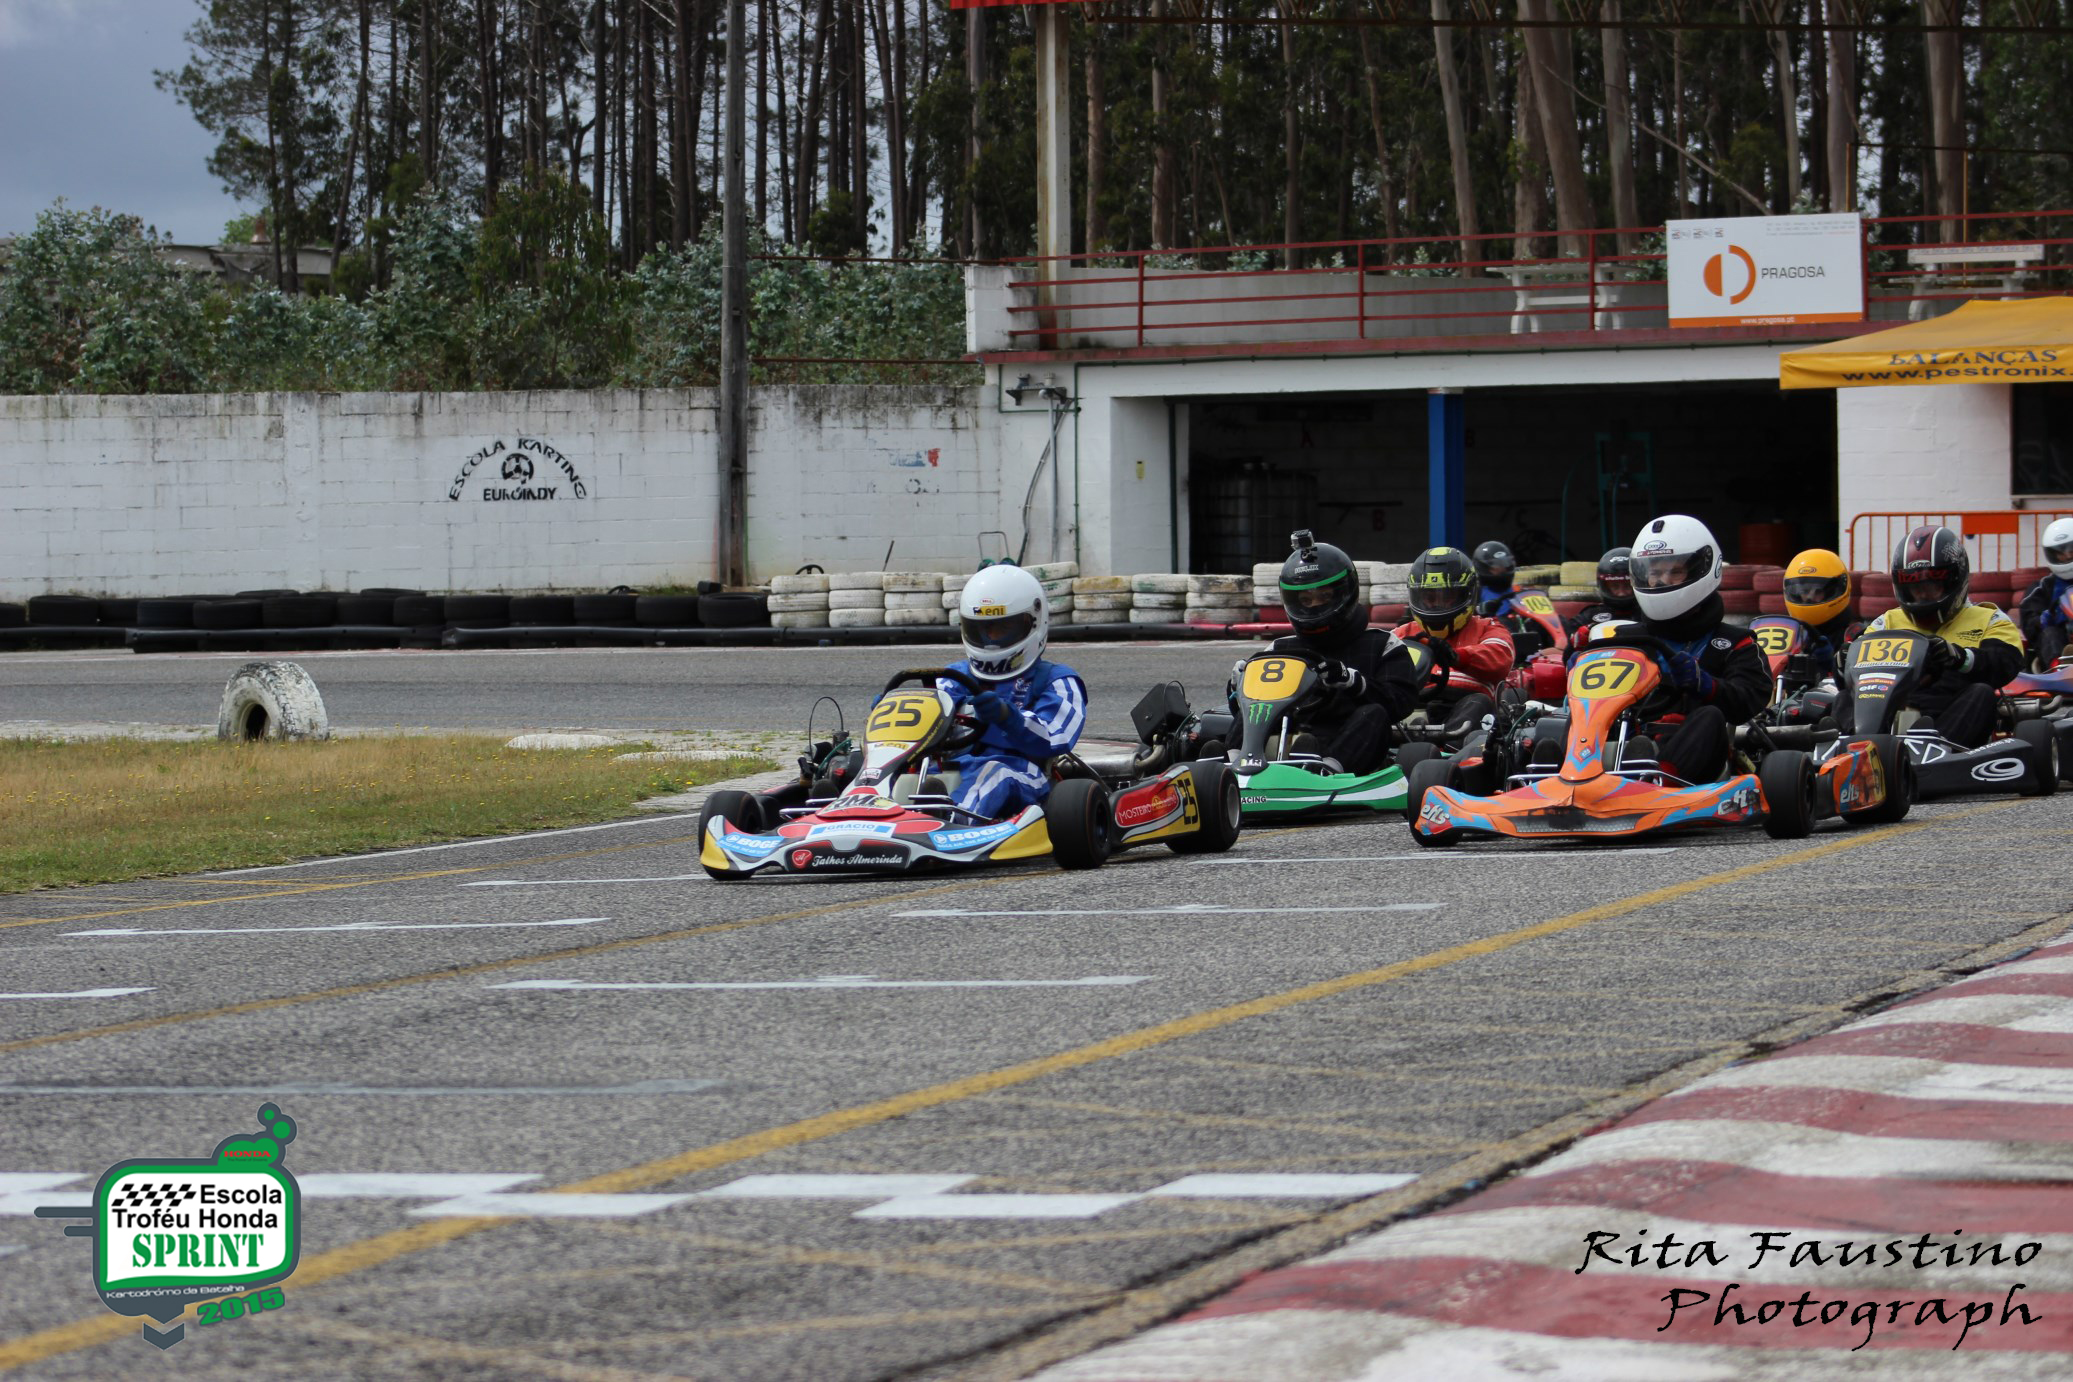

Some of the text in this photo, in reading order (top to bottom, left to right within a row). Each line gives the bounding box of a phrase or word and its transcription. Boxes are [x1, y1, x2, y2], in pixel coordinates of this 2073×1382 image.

[1761, 266, 1825, 279] PRAGOSA
[449, 440, 506, 501] ESCOLA
[1859, 640, 1910, 662] 136
[1260, 660, 1286, 682] 8
[1580, 661, 1636, 690] 67
[869, 699, 924, 733] 25
[1241, 796, 1267, 804] ACING
[947, 823, 1012, 842] BOGE
[736, 837, 780, 849] BOGE
[812, 853, 903, 867] Talhos Almerinda
